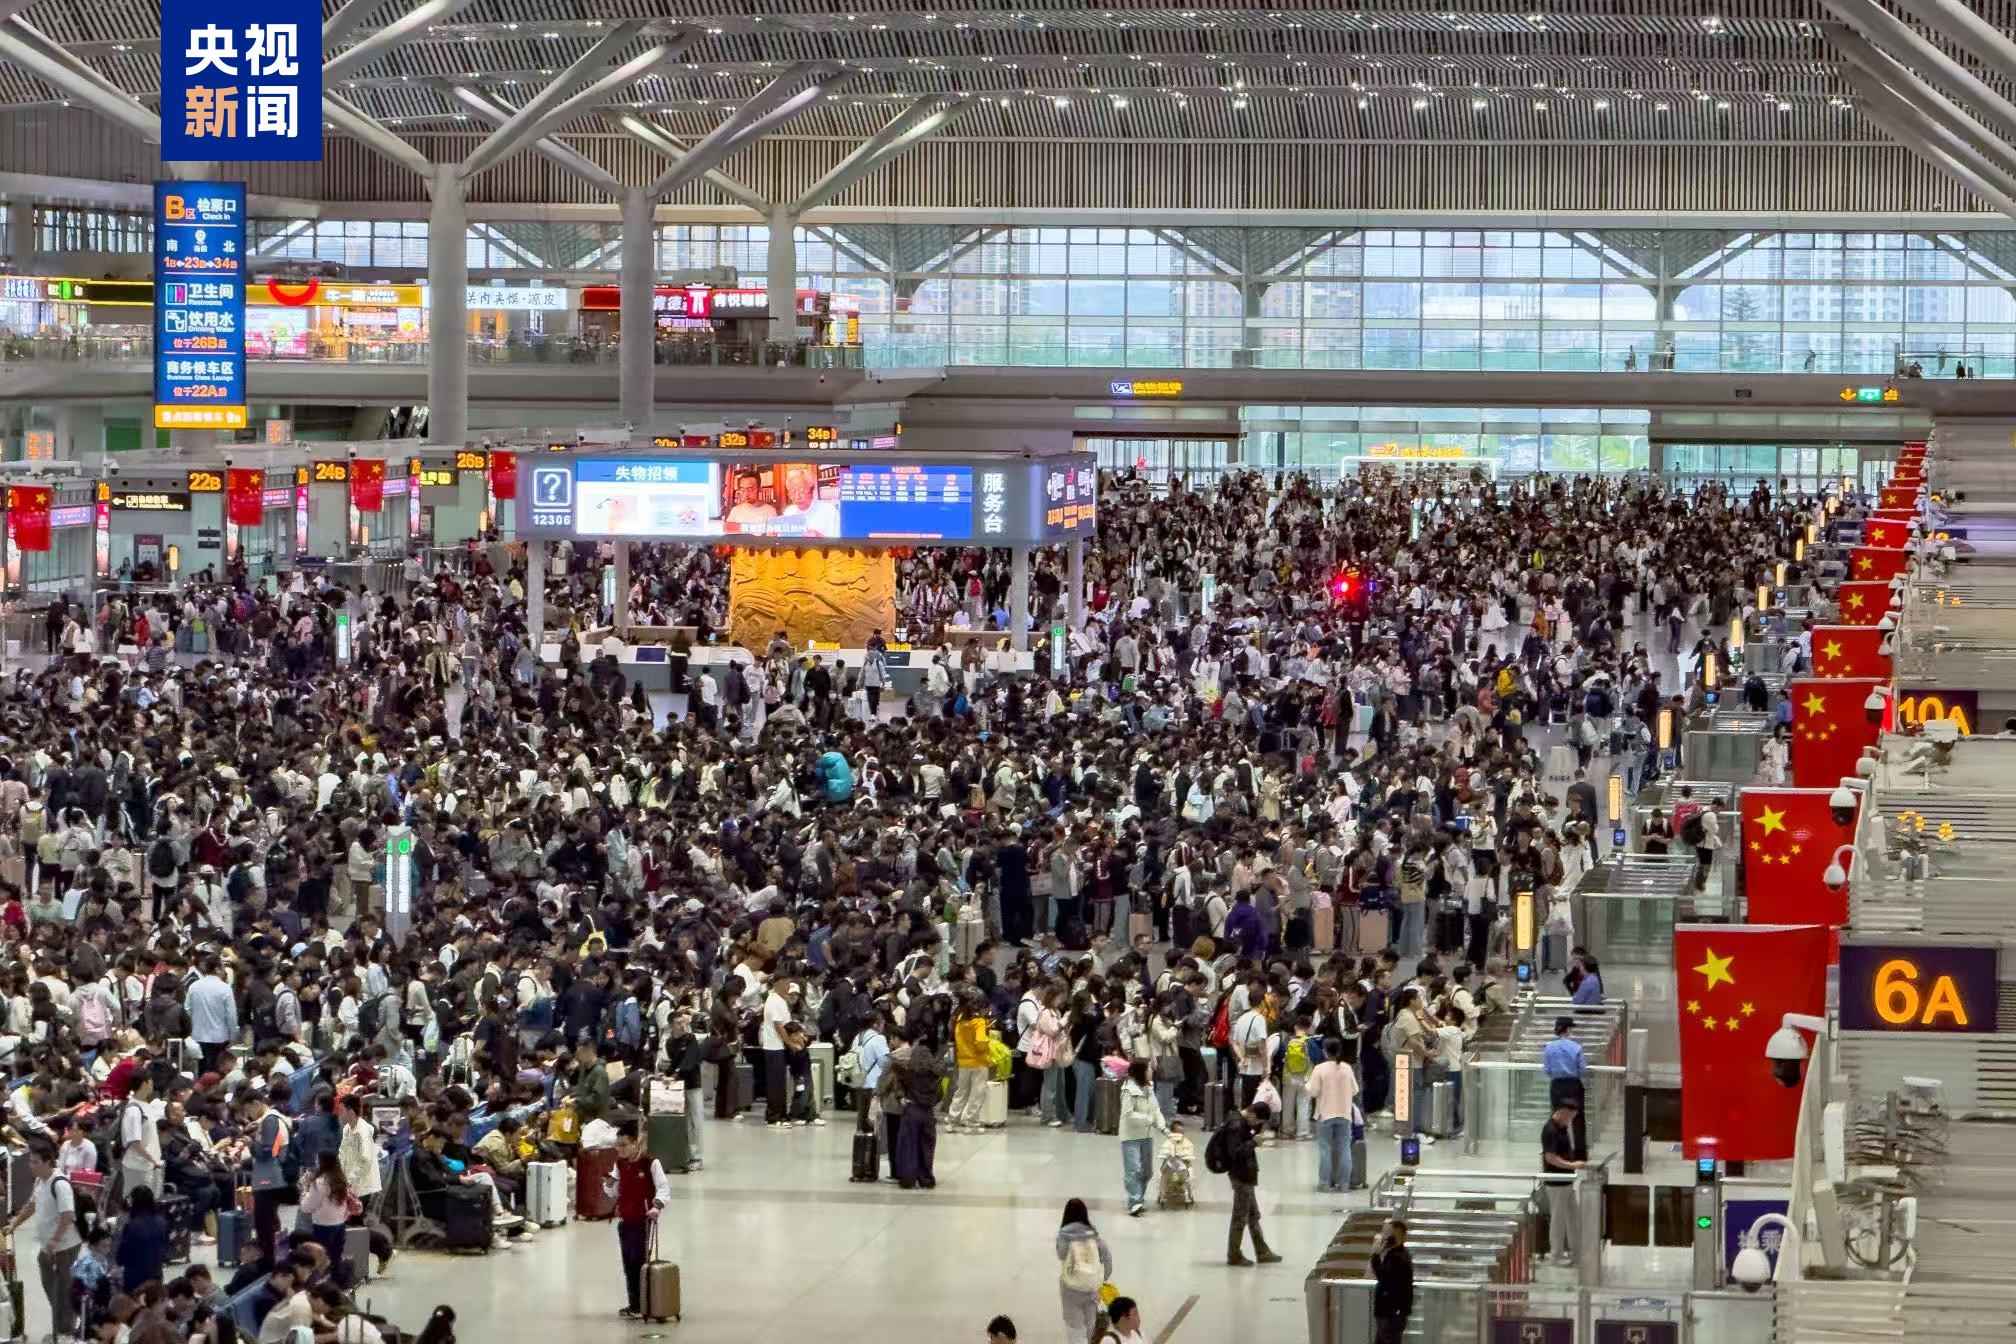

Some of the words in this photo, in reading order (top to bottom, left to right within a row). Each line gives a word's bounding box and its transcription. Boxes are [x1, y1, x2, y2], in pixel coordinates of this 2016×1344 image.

[197, 198, 236, 211] 检票口
[166, 239, 178, 252] 南
[223, 240, 235, 253] 北
[213, 256, 238, 269] 34B
[188, 283, 234, 299] 卫生间
[188, 311, 234, 326] 饮用水
[173, 336, 228, 349] 位于26B后
[166, 361, 234, 375] 商务候车区
[173, 385, 228, 397] 位于22A后
[724, 432, 747, 446] 32B
[807, 428, 831, 440] 34B
[457, 453, 485, 469] 26B
[316, 463, 346, 480] 24B
[615, 466, 678, 481] 失物招领
[189, 473, 222, 491] 22B
[983, 472, 1005, 533] 服务台
[533, 515, 571, 525] 12306
[1898, 696, 1971, 737] 10A
[1874, 959, 1967, 1025] 6A
